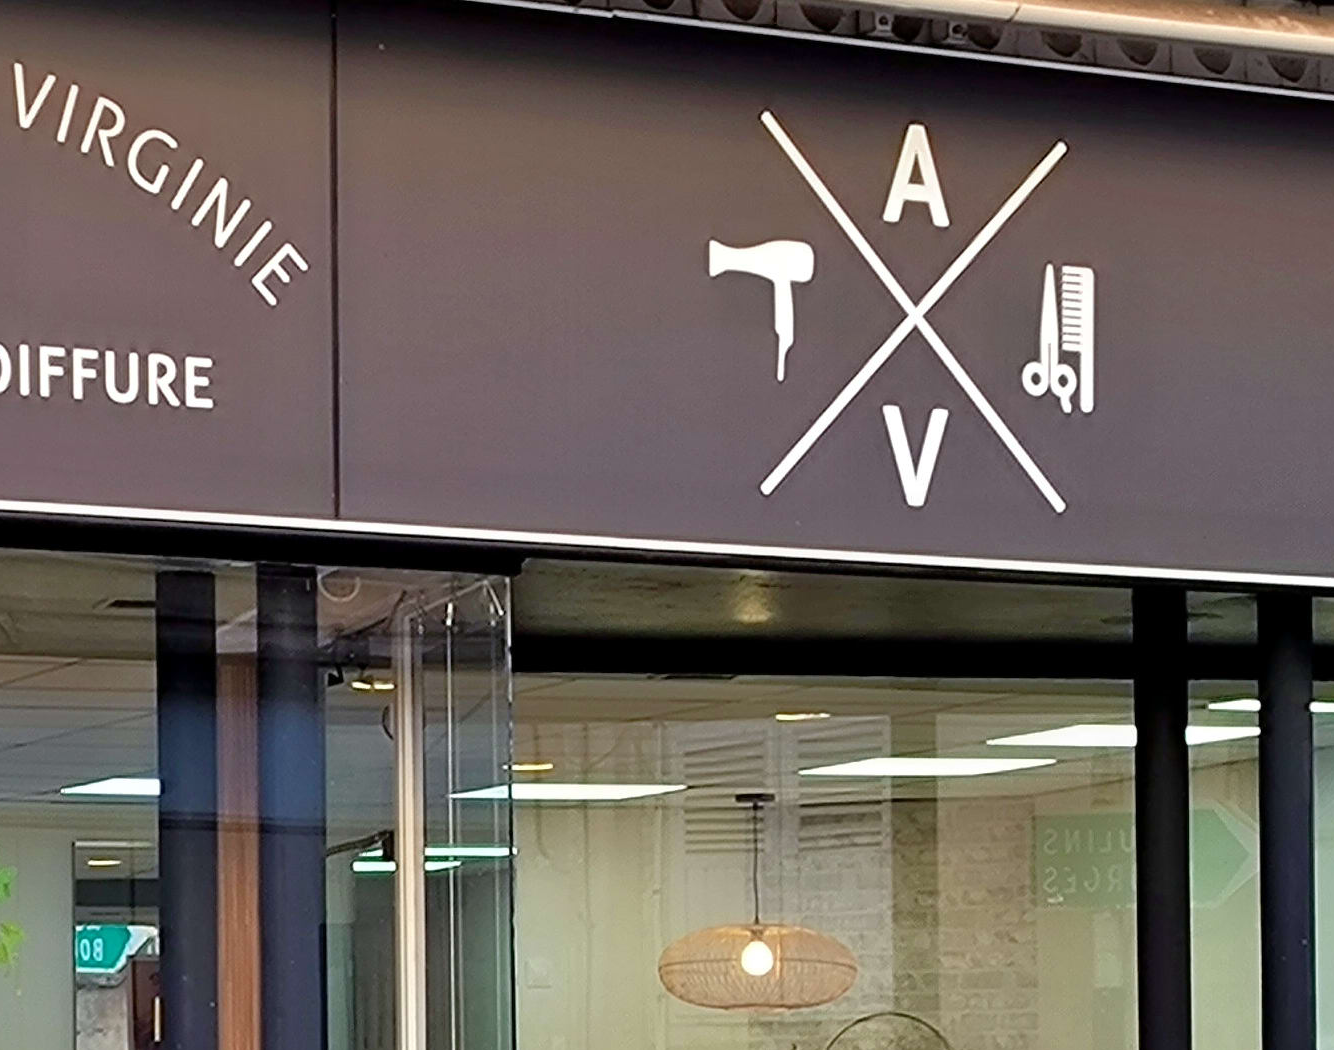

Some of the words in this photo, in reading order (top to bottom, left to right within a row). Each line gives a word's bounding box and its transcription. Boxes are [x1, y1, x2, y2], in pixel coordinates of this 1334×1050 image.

[14, 62, 309, 306] VIRGINIE
[883, 123, 950, 227] A
[882, 404, 949, 507] V
